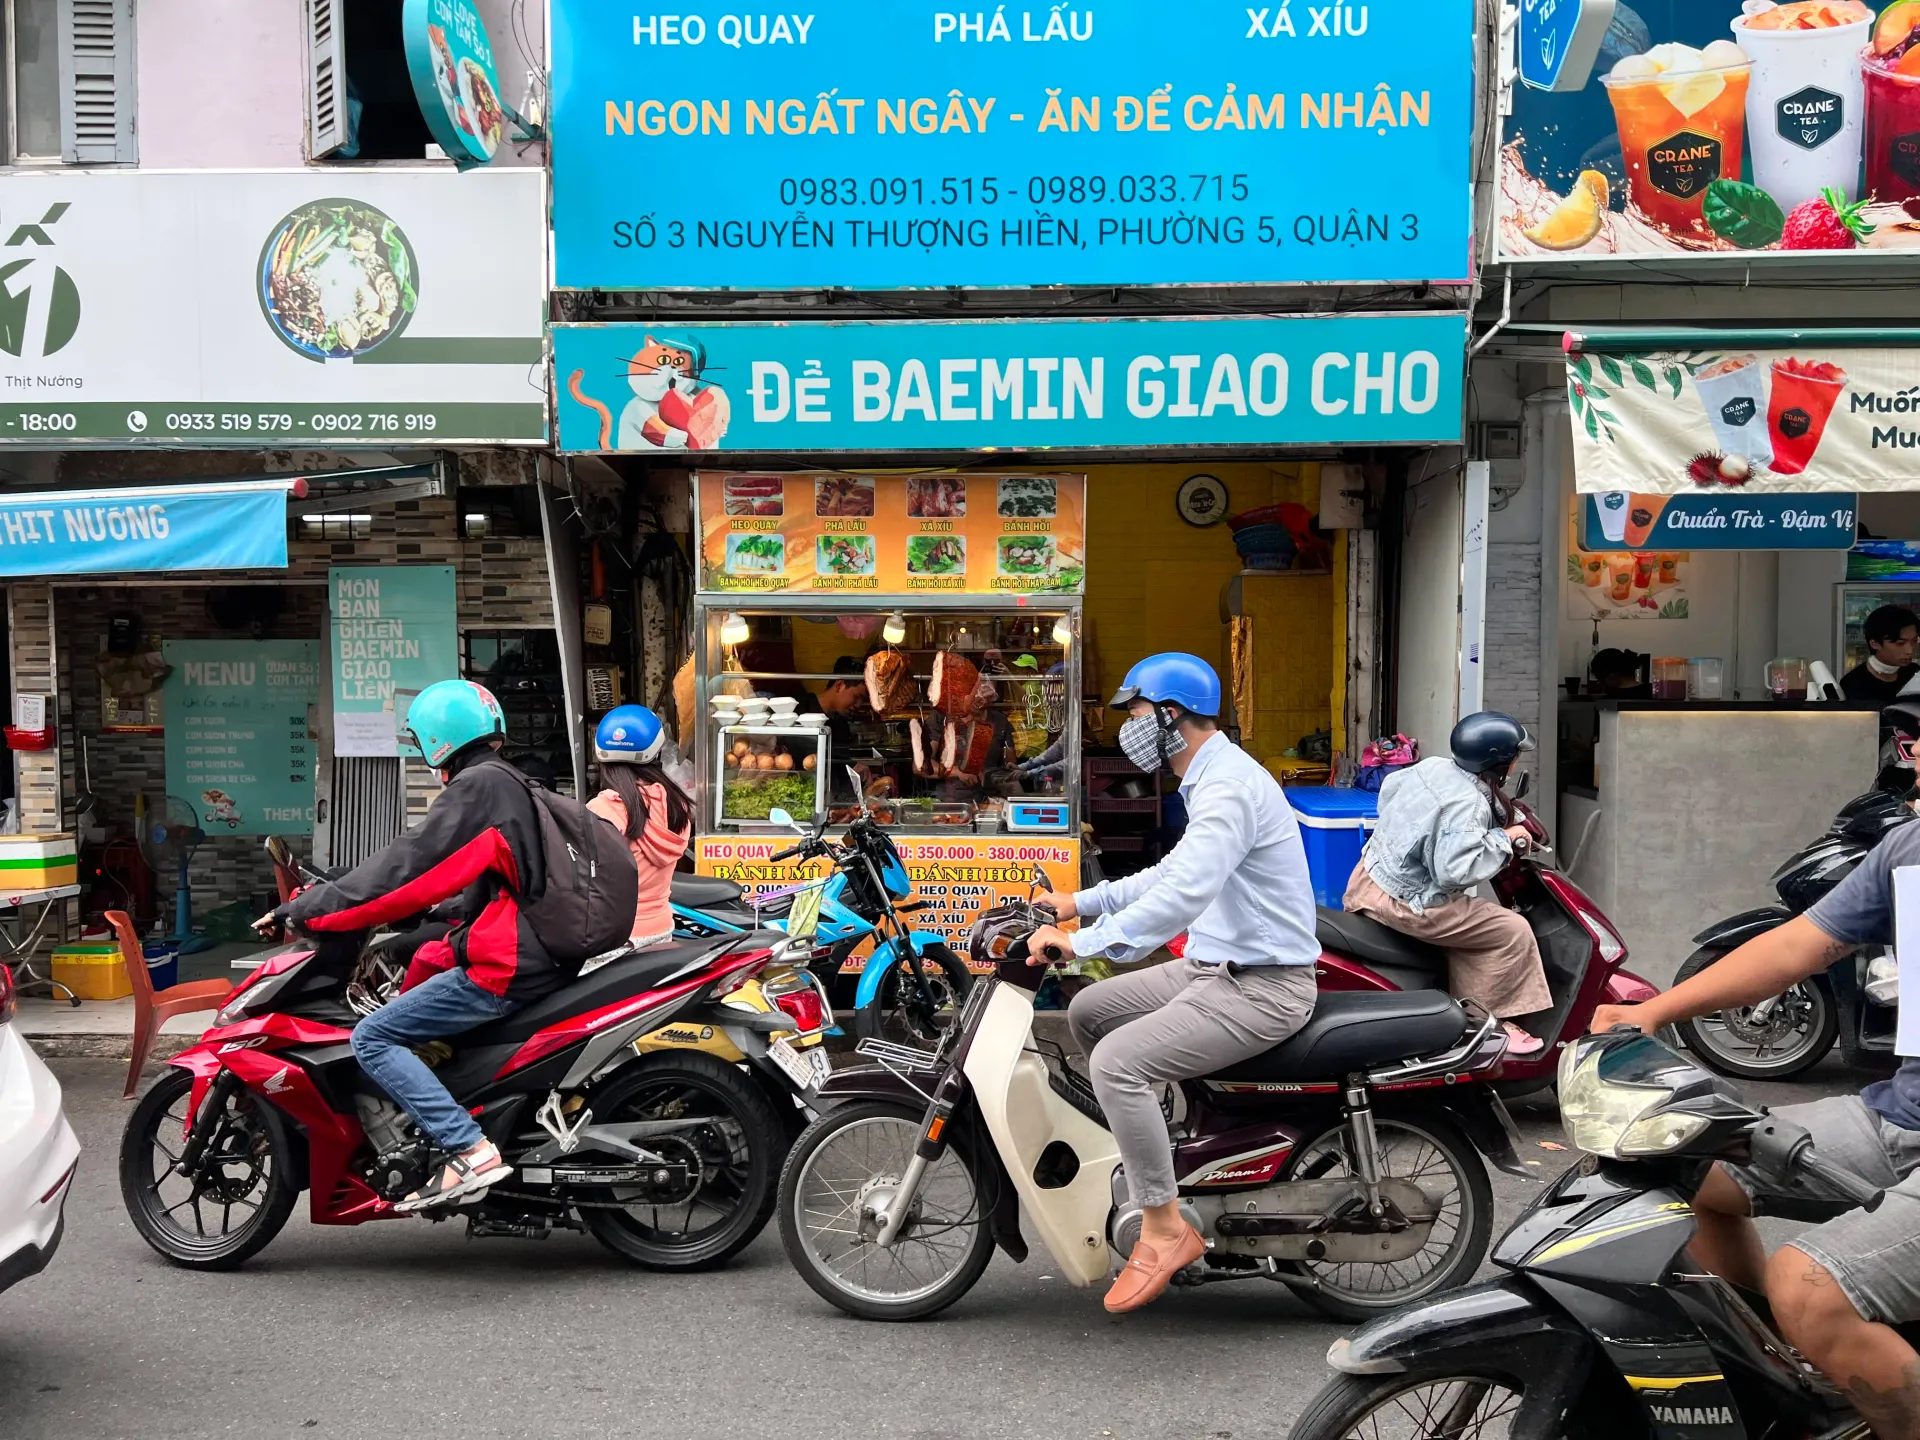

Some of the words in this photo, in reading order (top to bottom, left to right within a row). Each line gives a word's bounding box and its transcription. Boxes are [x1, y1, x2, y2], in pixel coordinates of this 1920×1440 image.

[934, 4, 1012, 43] PHÁ
[1022, 2, 1093, 42] LẤU
[1245, 2, 1295, 39] XÁ
[1307, 0, 1368, 37] XÍU
[632, 14, 706, 46] HEO
[717, 13, 815, 49] QUAY
[605, 99, 730, 136] NGON
[745, 88, 864, 136] NGẤT
[877, 89, 996, 135] NGÂY
[1037, 87, 1100, 133] ĂN
[1113, 82, 1172, 132] ĐỂ
[1184, 82, 1285, 131] CẢM
[1301, 82, 1430, 137] NHẬN
[1783, 100, 1834, 115] CRANE
[1799, 117, 1820, 126] TEA
[1653, 145, 1712, 163] CRANE
[1673, 164, 1694, 173] TEA
[779, 177, 998, 206] 0983.091.515
[1028, 173, 1249, 204] 0989.033.715
[612, 211, 656, 248] SỐ
[667, 220, 685, 248] 3
[697, 210, 833, 248] NGUYỄN
[845, 218, 988, 253] THƯỢNG
[1001, 209, 1086, 249] HIỀN,
[1099, 209, 1244, 247] PHƯỜNG
[1257, 216, 1282, 248] 5,
[1293, 207, 1389, 249] QUẬN
[1400, 213, 1419, 242] 3
[5, 374, 33, 390] Thịt
[36, 373, 83, 390] Nướng
[746, 359, 831, 423] ĐỂ
[852, 357, 1104, 422] BAEMIN
[1127, 353, 1290, 419] GIAO
[1311, 350, 1440, 415] CHO
[1724, 401, 1750, 414] CRANE
[19, 413, 77, 431] 18:00
[166, 413, 217, 431] 0933
[221, 413, 252, 431] 519
[257, 413, 293, 432] 579
[312, 414, 363, 431] 0902
[368, 413, 400, 432] 716
[404, 413, 437, 432] 919
[1872, 426, 1920, 449] Mu
[731, 520, 750, 530] HEO
[752, 520, 778, 531] QUAY
[847, 518, 867, 531] LẤU
[920, 519, 934, 531] XÁ
[937, 519, 953, 531] XÍU
[1004, 520, 1030, 531] BÁNH
[1667, 507, 1728, 529] Chuẩn
[1731, 509, 1765, 529] Trà
[1781, 509, 1828, 531] Đậm
[1831, 509, 1854, 532] Vị
[754, 576, 769, 588] HEO
[770, 577, 790, 588] QUAY
[813, 577, 833, 588] BÁNH
[847, 575, 863, 588] PHÁ
[864, 575, 878, 588] LẤU
[907, 576, 927, 588] BÁNH
[954, 576, 966, 588] XÍU
[991, 577, 1011, 588] BÁNH
[340, 639, 419, 659] BAEMIN
[184, 661, 256, 687] MENU
[341, 659, 391, 680] GIAO
[704, 845, 736, 858] HEO
[736, 845, 774, 859] QUAY
[917, 846, 974, 859] 350.000
[988, 846, 1070, 863] 380.000/kg
[713, 861, 785, 881] BÁNH
[788, 862, 822, 881] MÌ
[909, 862, 981, 882] BÁNH
[984, 862, 1034, 883] HỎI
[919, 885, 947, 895] HEO
[951, 885, 989, 896] QUAY
[952, 896, 980, 910] LẤU
[918, 912, 937, 924] XÁ
[943, 912, 966, 924] XÍU
[1201, 1169, 1261, 1181] Dream
[1649, 1404, 1735, 1425] YAMAHA
